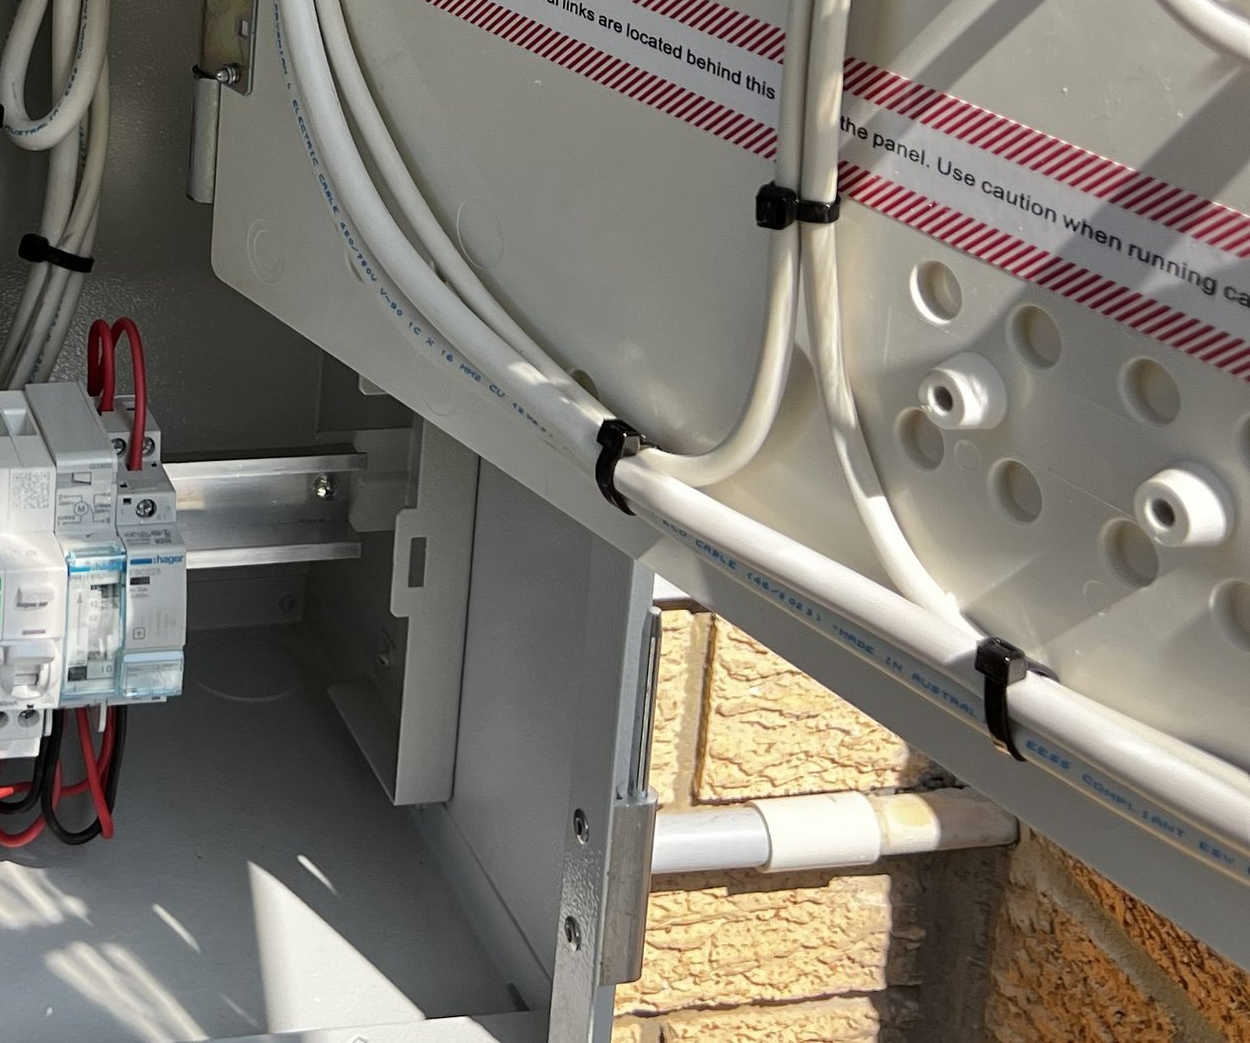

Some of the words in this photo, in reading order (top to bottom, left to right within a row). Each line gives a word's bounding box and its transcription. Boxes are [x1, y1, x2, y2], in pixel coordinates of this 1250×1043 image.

[291, 98, 319, 167] ELECTRIC
[317, 172, 340, 215] CABLE
[379, 287, 404, 318] V-90
[425, 337, 436, 347] X
[458, 363, 483, 383] MM2
[488, 384, 506, 399] CU
[598, 13, 623, 34] are
[626, 23, 683, 60] located
[686, 49, 742, 86] behind
[745, 74, 776, 100] this
[839, 115, 869, 140] the
[872, 133, 931, 169] panel.
[937, 156, 976, 187] Use
[981, 180, 1057, 223] caution
[1062, 213, 1122, 252] when
[1127, 242, 1218, 297] running
[694, 538, 737, 572] CABLE
[884, 656, 903, 673] IN
[1081, 772, 1186, 838] COMPLIANT
